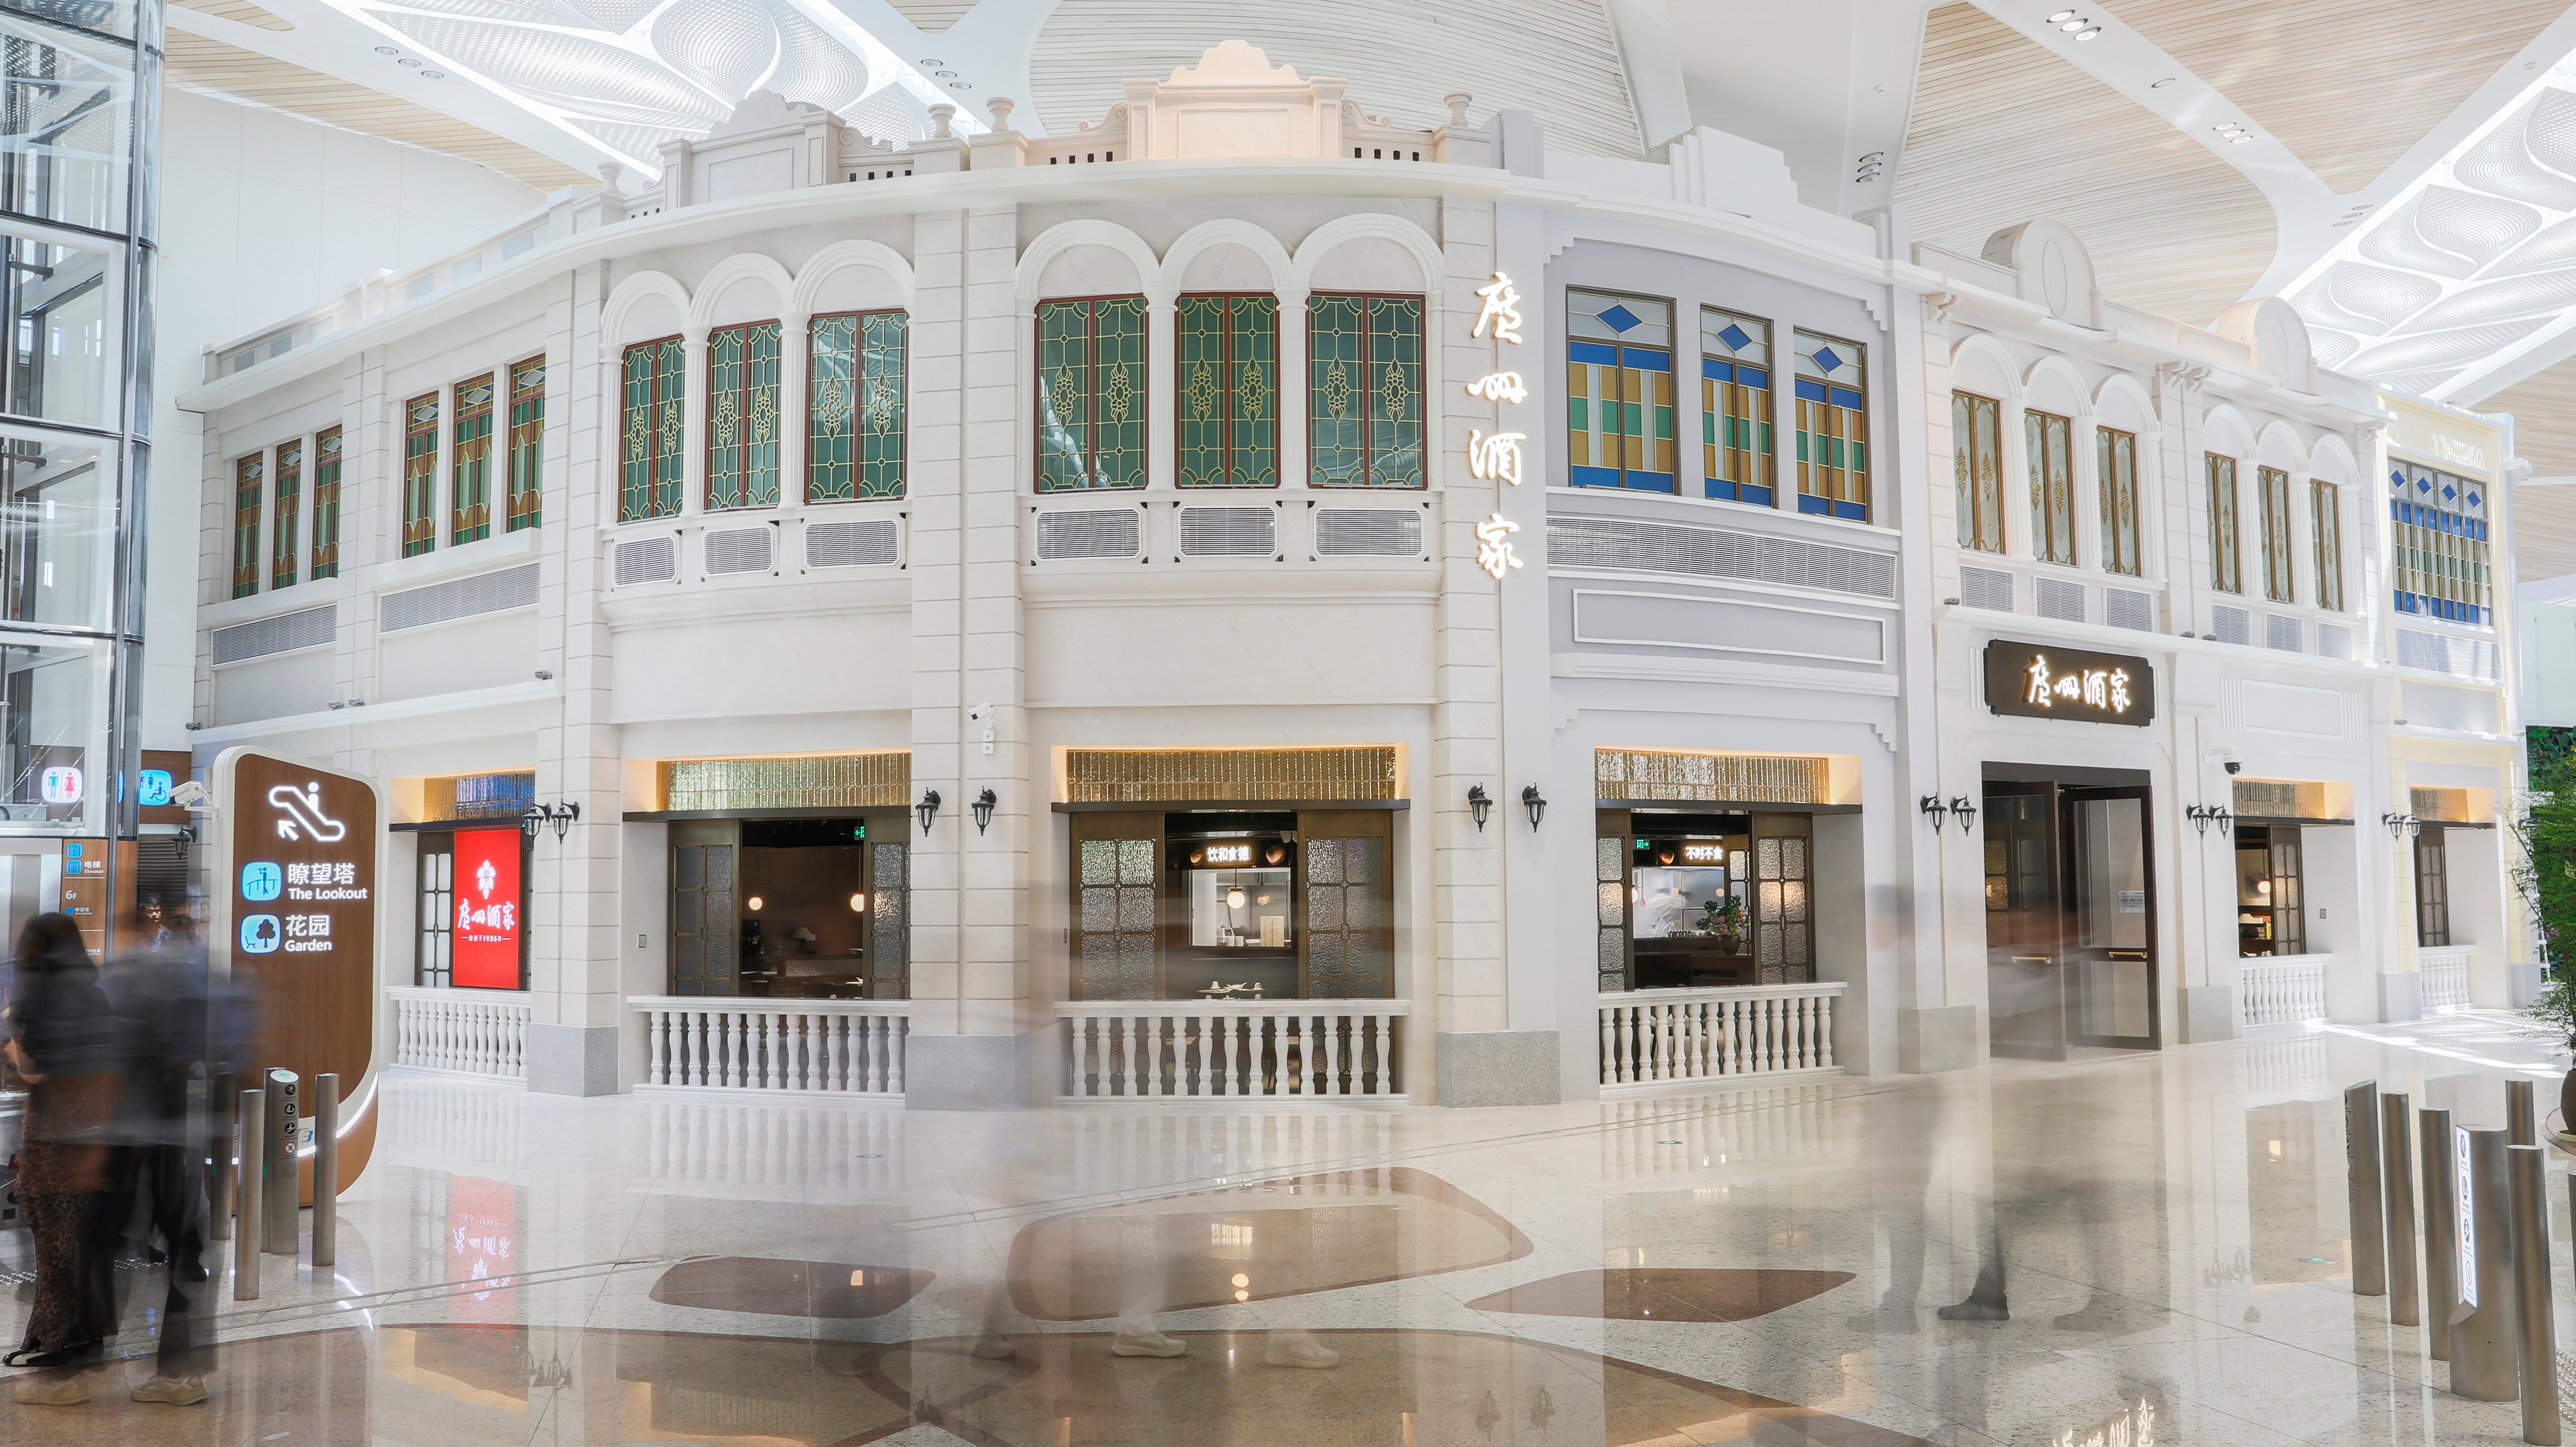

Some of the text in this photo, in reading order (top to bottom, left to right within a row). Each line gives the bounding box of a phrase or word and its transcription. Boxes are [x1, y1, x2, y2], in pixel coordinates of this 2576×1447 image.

[1207, 845, 1250, 862] 饮和食德
[1686, 846, 1723, 860] 不时不食
[84, 860, 102, 868] 电梯
[288, 863, 355, 885] 瞭望塔
[65, 890, 77, 899] 6F
[288, 887, 368, 900] The Lookout
[285, 914, 330, 937] 花园
[284, 938, 332, 952] Garden
